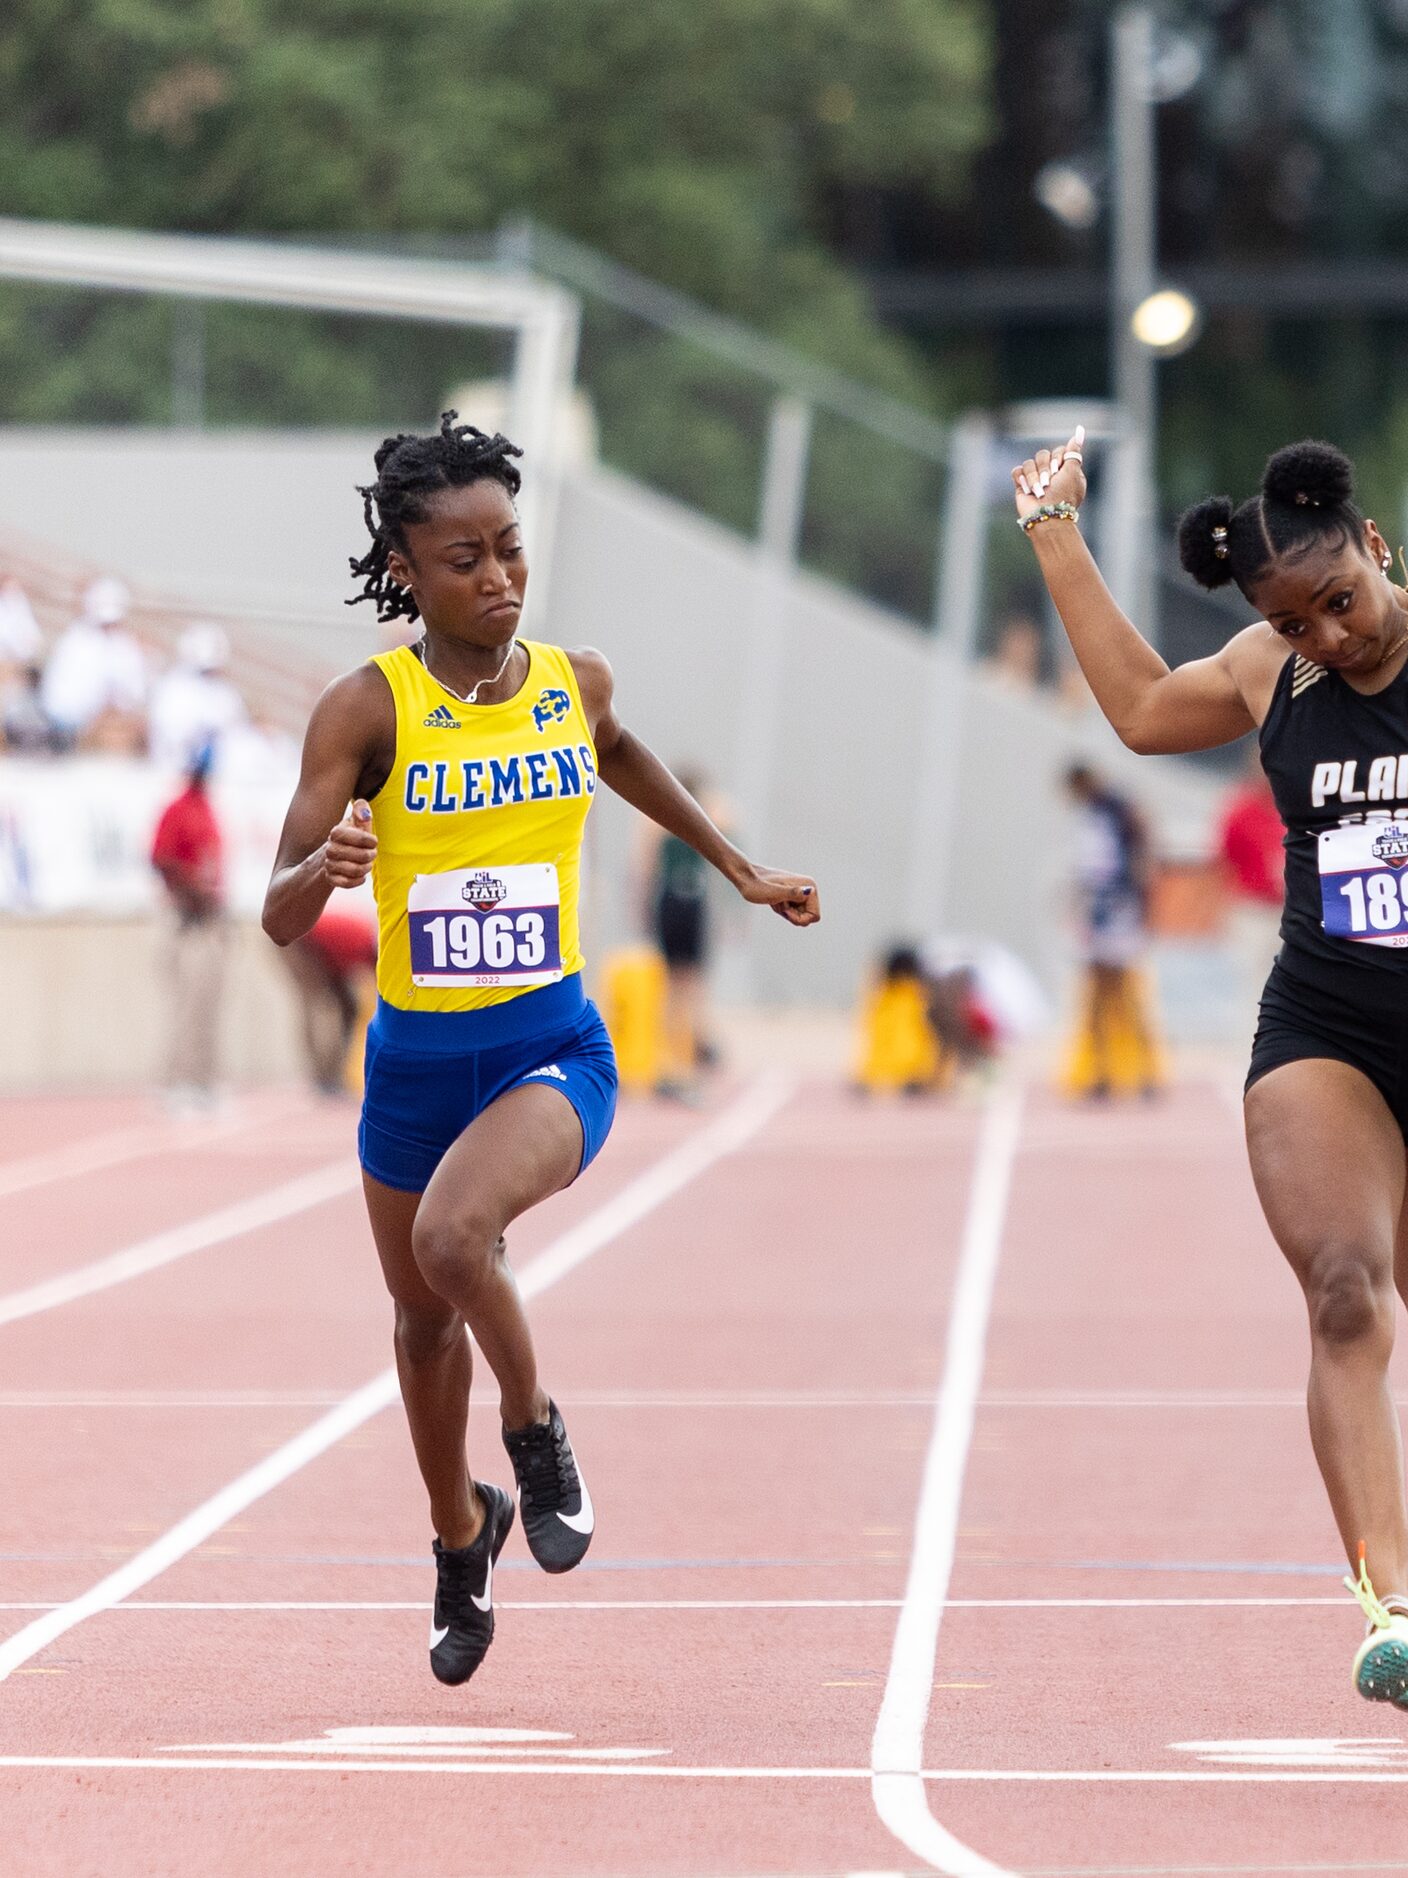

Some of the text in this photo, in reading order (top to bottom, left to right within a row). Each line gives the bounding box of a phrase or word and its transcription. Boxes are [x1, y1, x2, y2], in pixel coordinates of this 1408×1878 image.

[423, 717, 462, 729] adidas
[405, 745, 596, 813] CLEMENS
[462, 886, 506, 899] STATE
[423, 913, 545, 969] 1963
[475, 976, 500, 984] 2022
